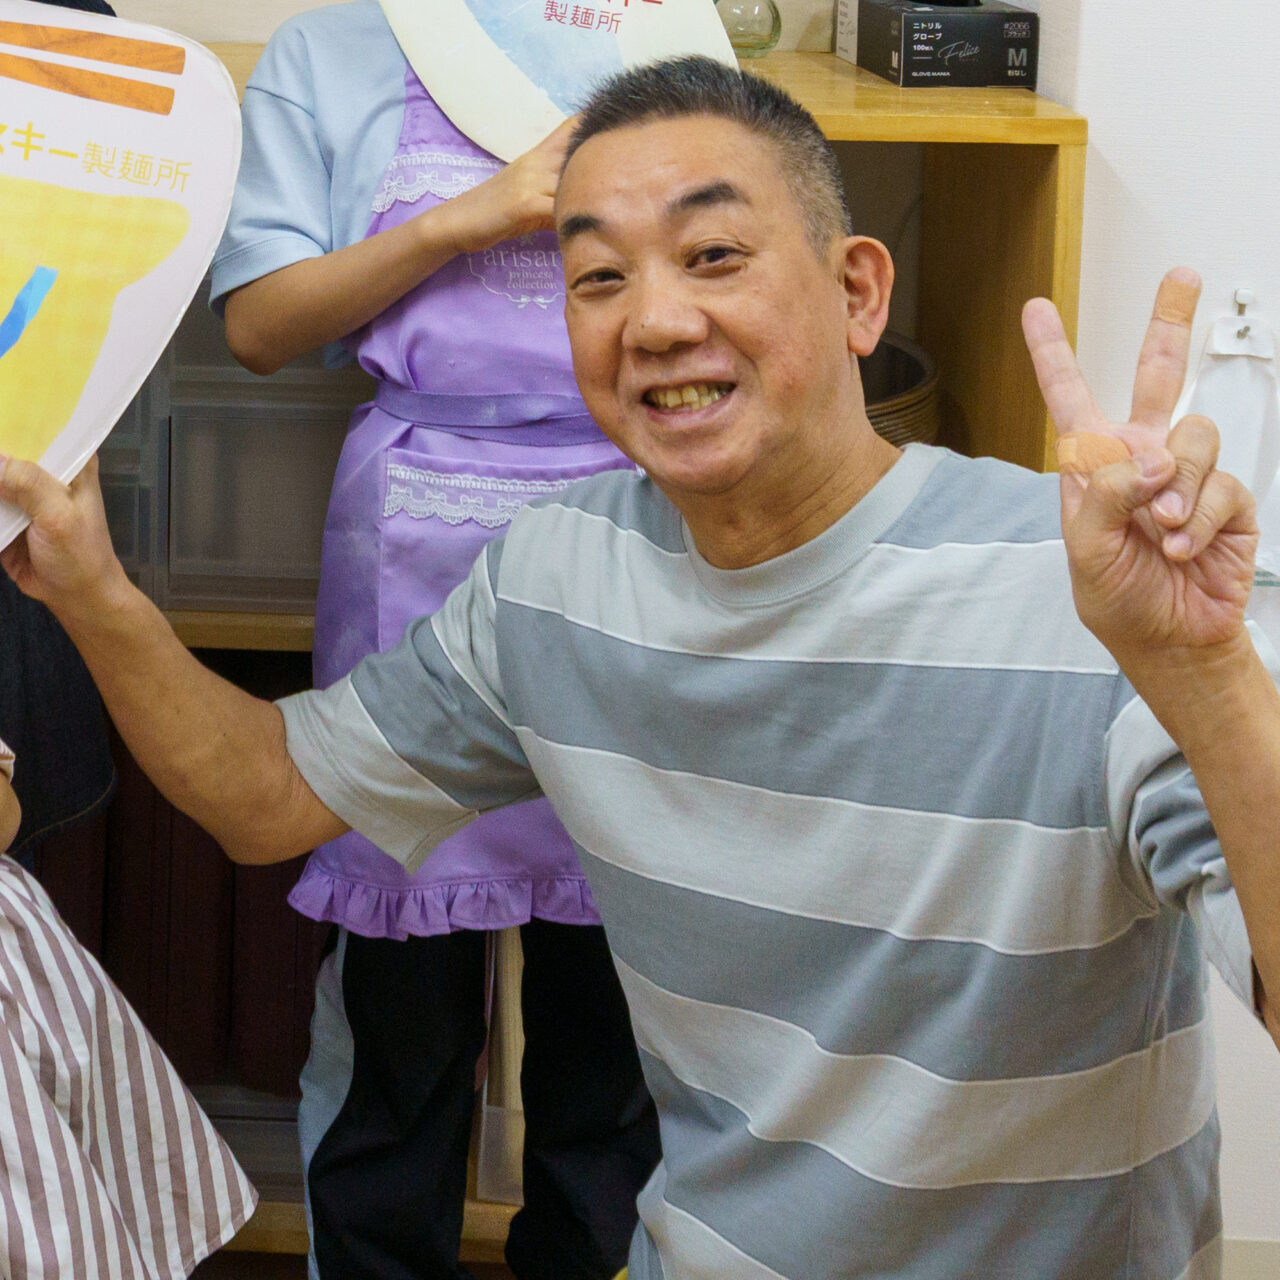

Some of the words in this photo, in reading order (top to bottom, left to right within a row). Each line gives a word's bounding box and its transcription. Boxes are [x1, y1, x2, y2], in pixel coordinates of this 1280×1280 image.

[543, 0, 623, 35] 製麺所
[913, 22, 942, 30] ニトリル
[1008, 48, 1028, 67] M
[506, 278, 558, 290] collection
